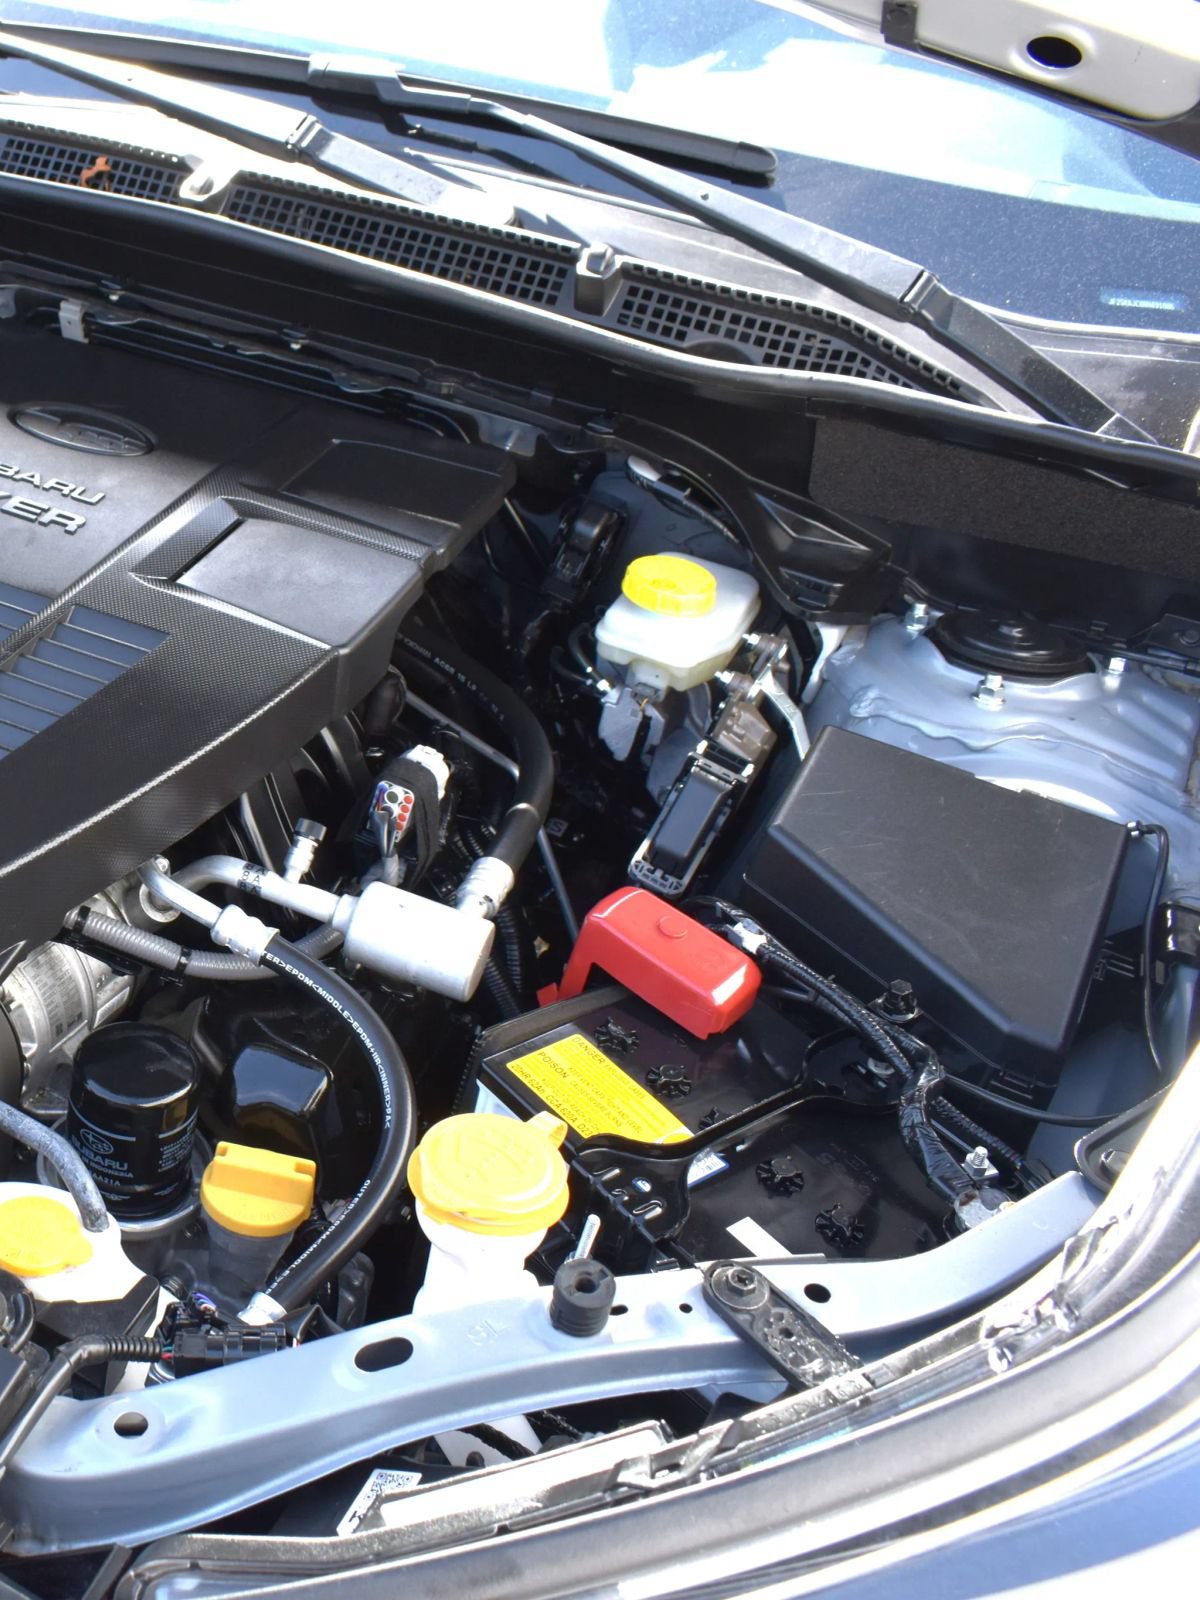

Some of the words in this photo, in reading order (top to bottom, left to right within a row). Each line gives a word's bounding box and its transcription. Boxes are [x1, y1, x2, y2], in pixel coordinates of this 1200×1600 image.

[537, 1051, 569, 1079] POISON
[572, 1036, 606, 1065] DANGER
[71, 1134, 129, 1171] SUBARU
